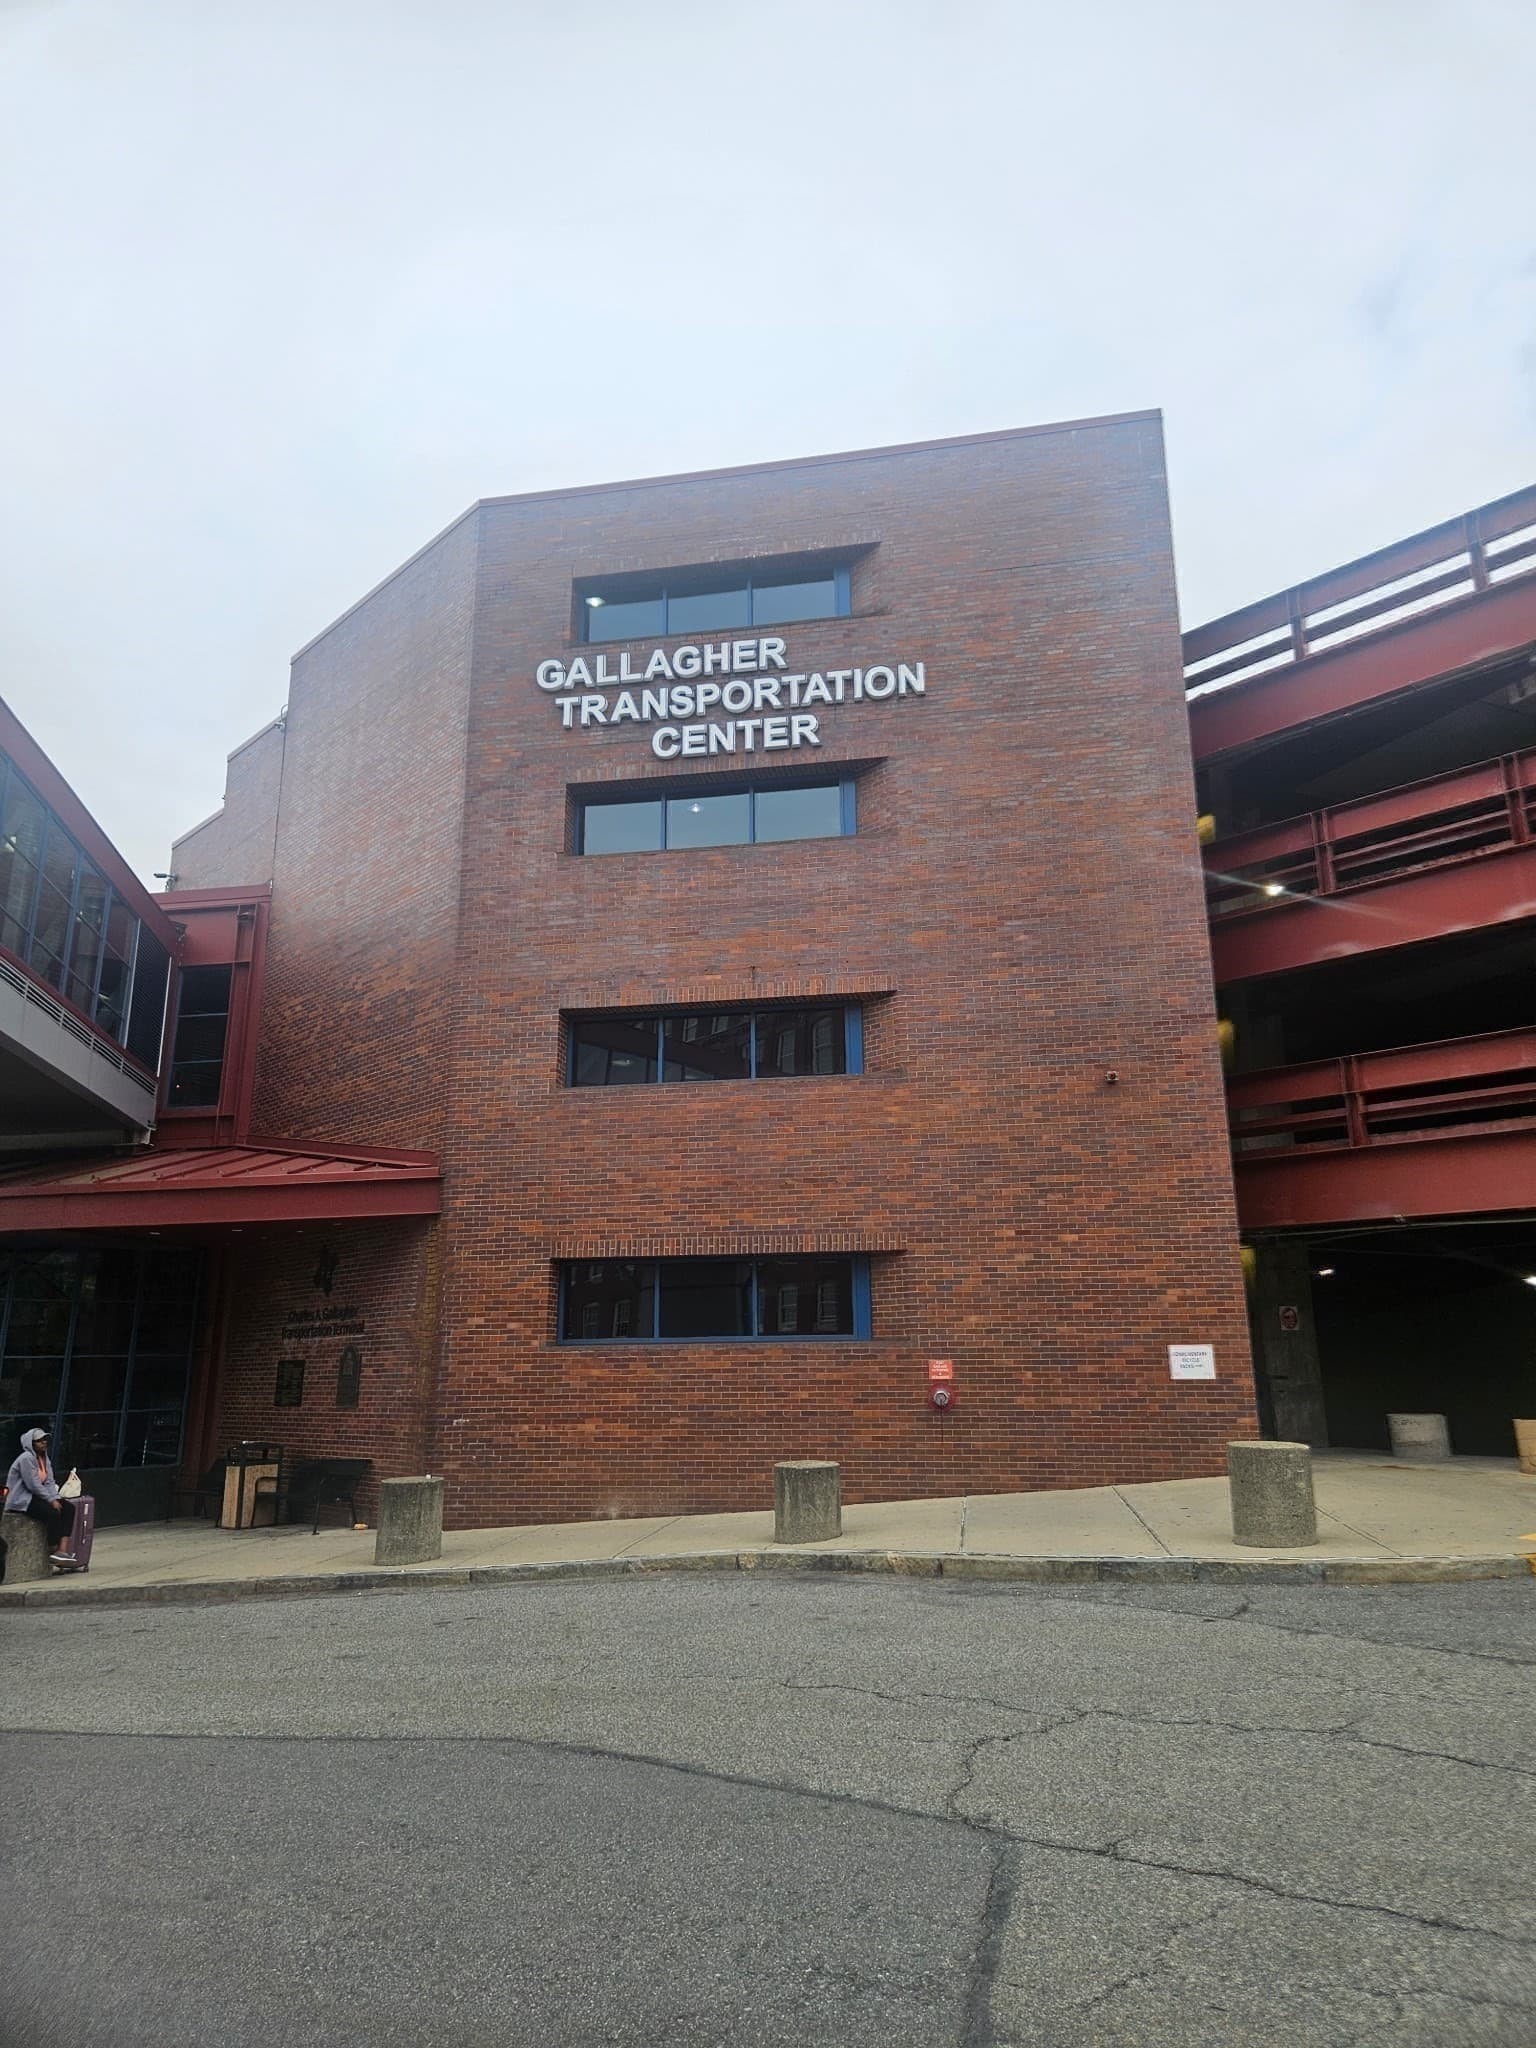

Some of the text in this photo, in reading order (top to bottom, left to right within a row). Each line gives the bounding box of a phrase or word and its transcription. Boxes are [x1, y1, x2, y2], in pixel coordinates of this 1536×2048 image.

[536, 637, 787, 690] GALLAGHER
[555, 661, 928, 728] TRANSPORTATION
[652, 713, 822, 759] CENTER
